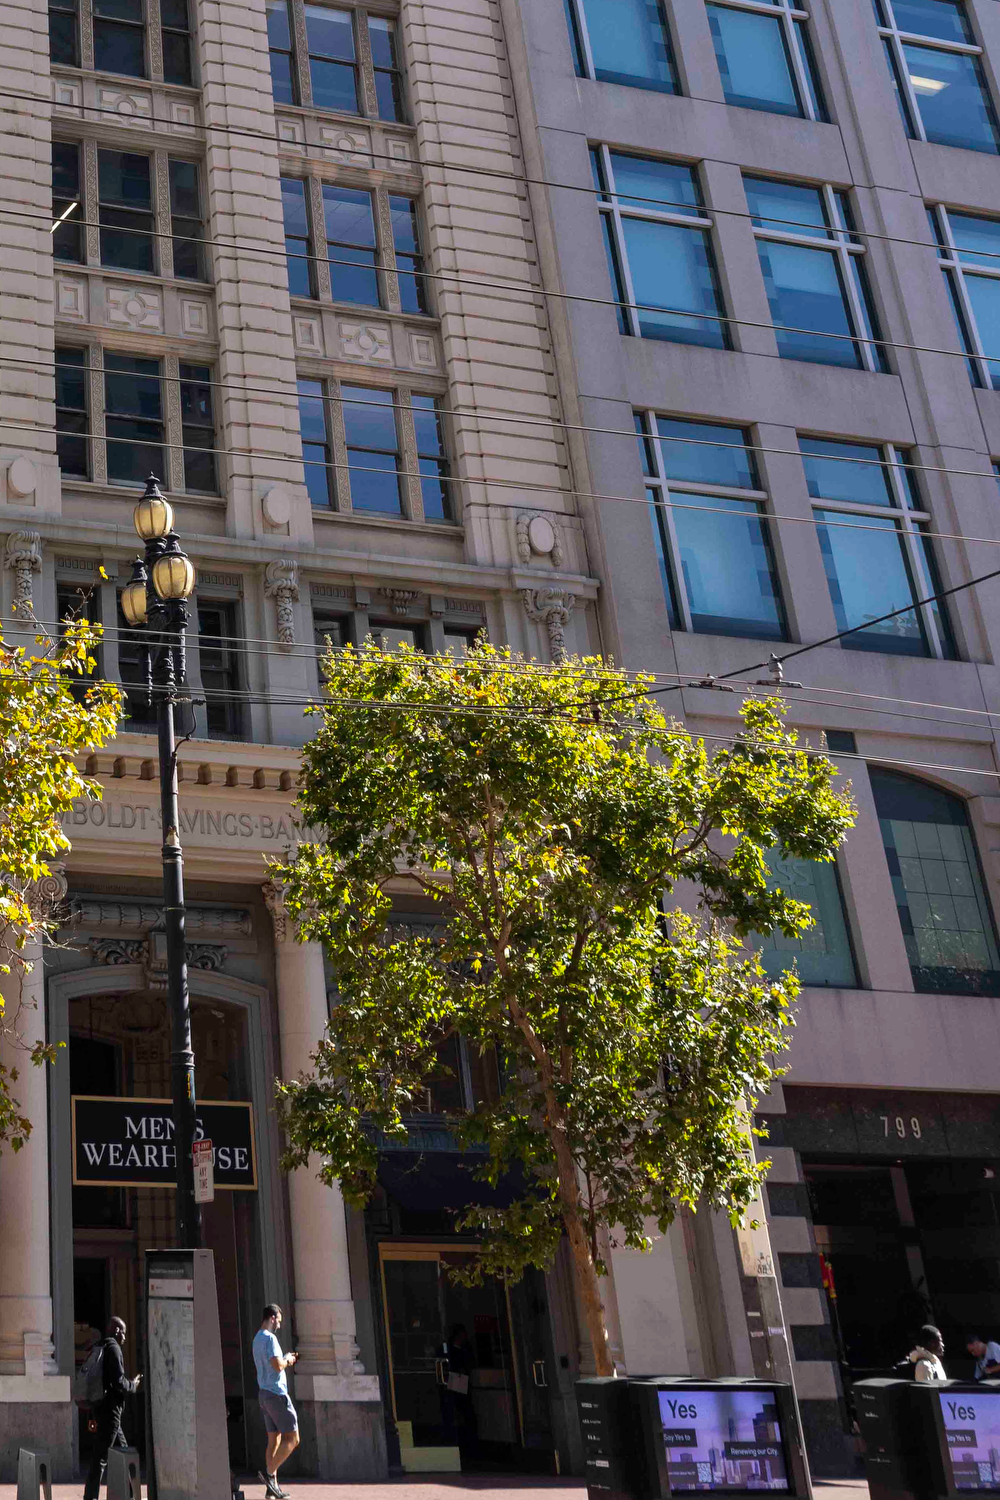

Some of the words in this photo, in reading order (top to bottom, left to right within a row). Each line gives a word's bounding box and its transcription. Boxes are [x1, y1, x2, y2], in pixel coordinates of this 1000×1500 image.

[879, 1116, 921, 1138] 799
[667, 1399, 698, 1419] Yes
[947, 1401, 976, 1420] Yes
[730, 1447, 757, 1457] Renewing
[757, 1448, 766, 1456] our
